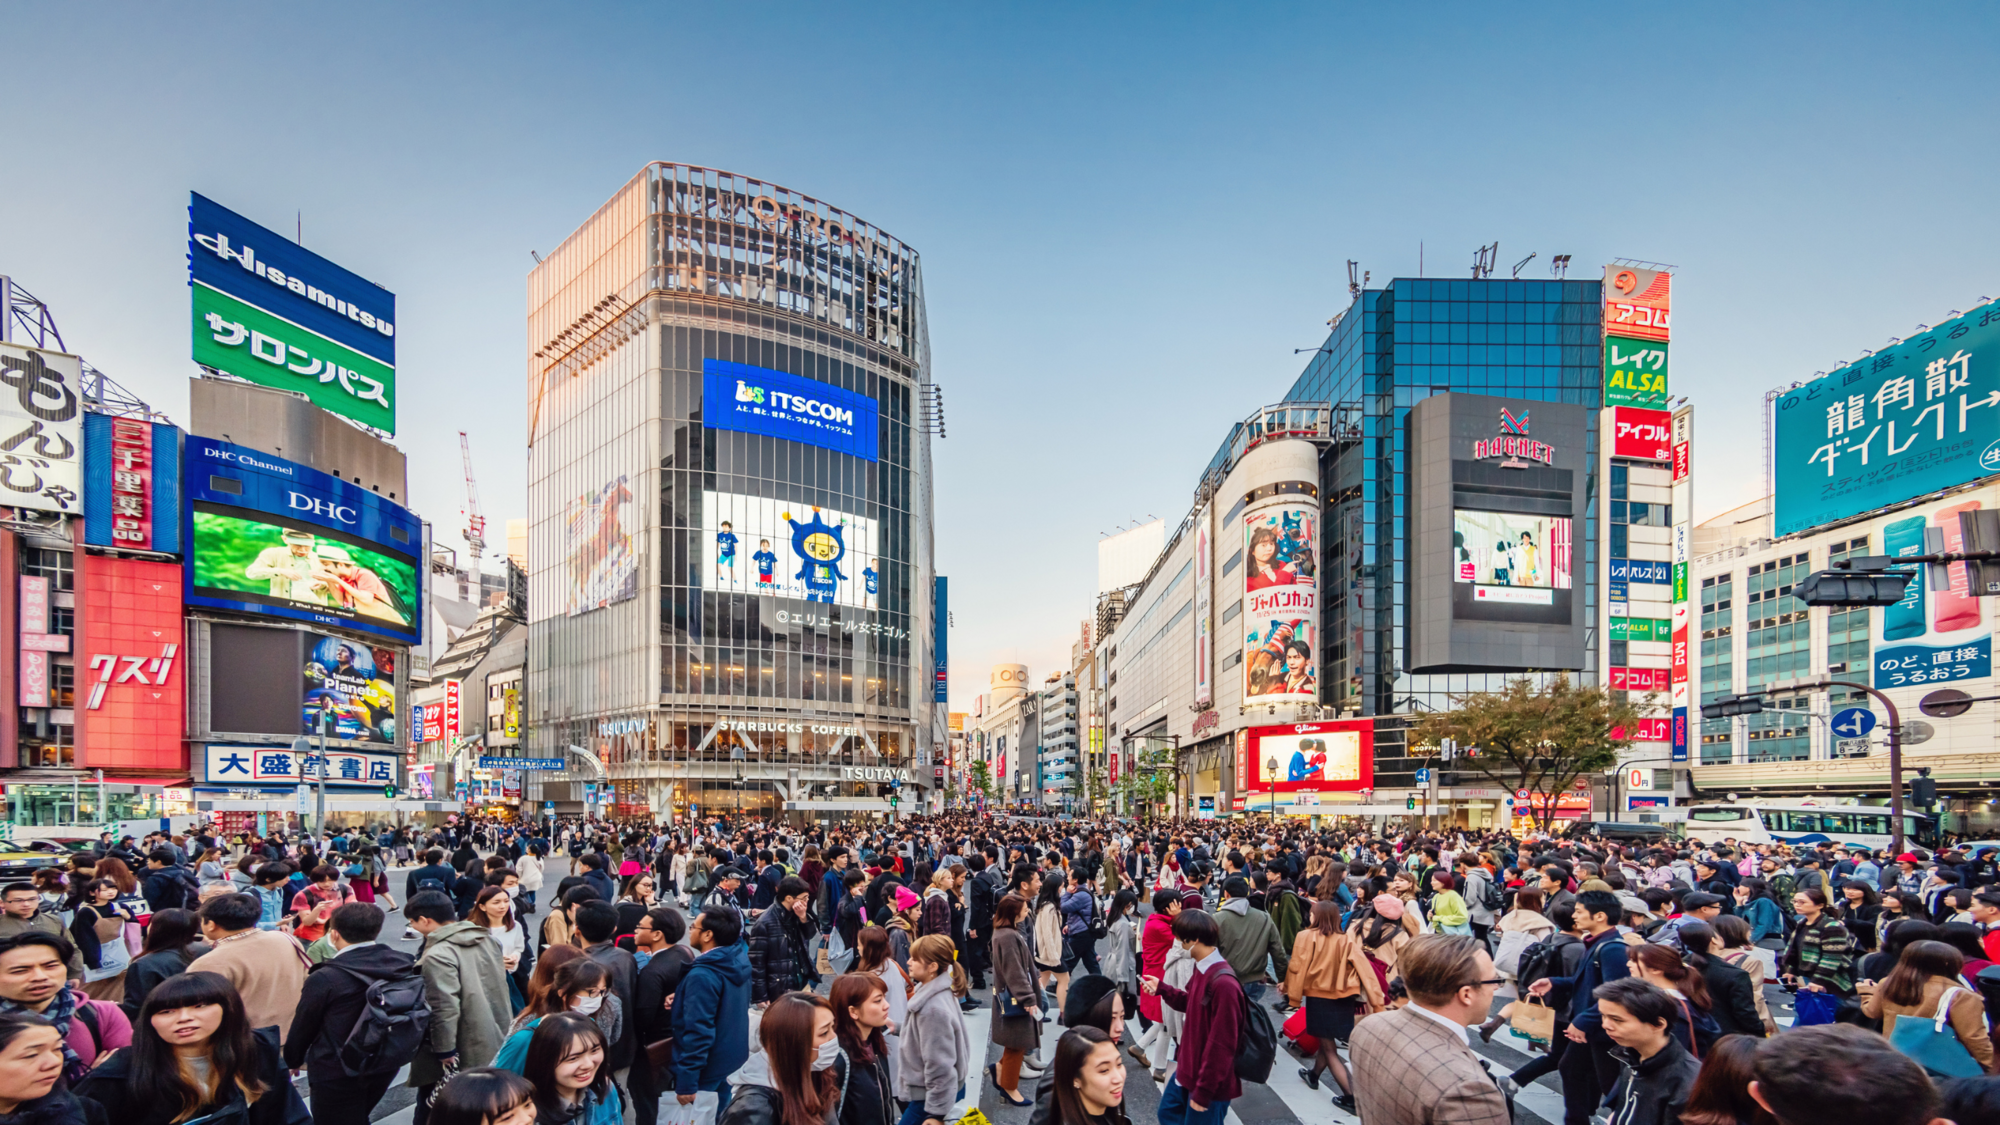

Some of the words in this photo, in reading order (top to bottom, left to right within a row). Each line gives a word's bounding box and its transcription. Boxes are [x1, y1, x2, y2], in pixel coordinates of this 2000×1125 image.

[194, 232, 394, 338] Hisamitsu
[1616, 303, 1670, 328] アコム
[205, 312, 389, 409] サロンパス
[1611, 345, 1665, 370] レイク
[1609, 370, 1665, 394] ALSA
[1826, 349, 1972, 439] 龍角散
[1617, 422, 1670, 442] アイフル
[1807, 392, 1995, 477] ダイレクト
[204, 447, 236, 462] DHC
[238, 455, 293, 476] Channel
[1474, 436, 1555, 466] MAGNET
[1655, 449, 1669, 460] 8F
[112, 421, 145, 543] 三千里薬品
[1821, 461, 1898, 495] スティック
[1905, 452, 1938, 467] ミント
[288, 491, 357, 525] DHC
[1659, 626, 1669, 634] 5F
[1880, 647, 1989, 672] のど、直接、
[332, 672, 366, 685] teamLab
[1614, 673, 1652, 685] アコム
[1889, 664, 1971, 686] うるおう
[324, 678, 378, 698] Planets
[341, 694, 365, 702] TOKYO
[447, 685, 458, 726] カラオケ
[720, 720, 803, 733] STARBUCKS
[811, 724, 858, 736] COFFEE
[1675, 715, 1685, 747] PROMISE
[844, 767, 909, 781] TSUTAYA
